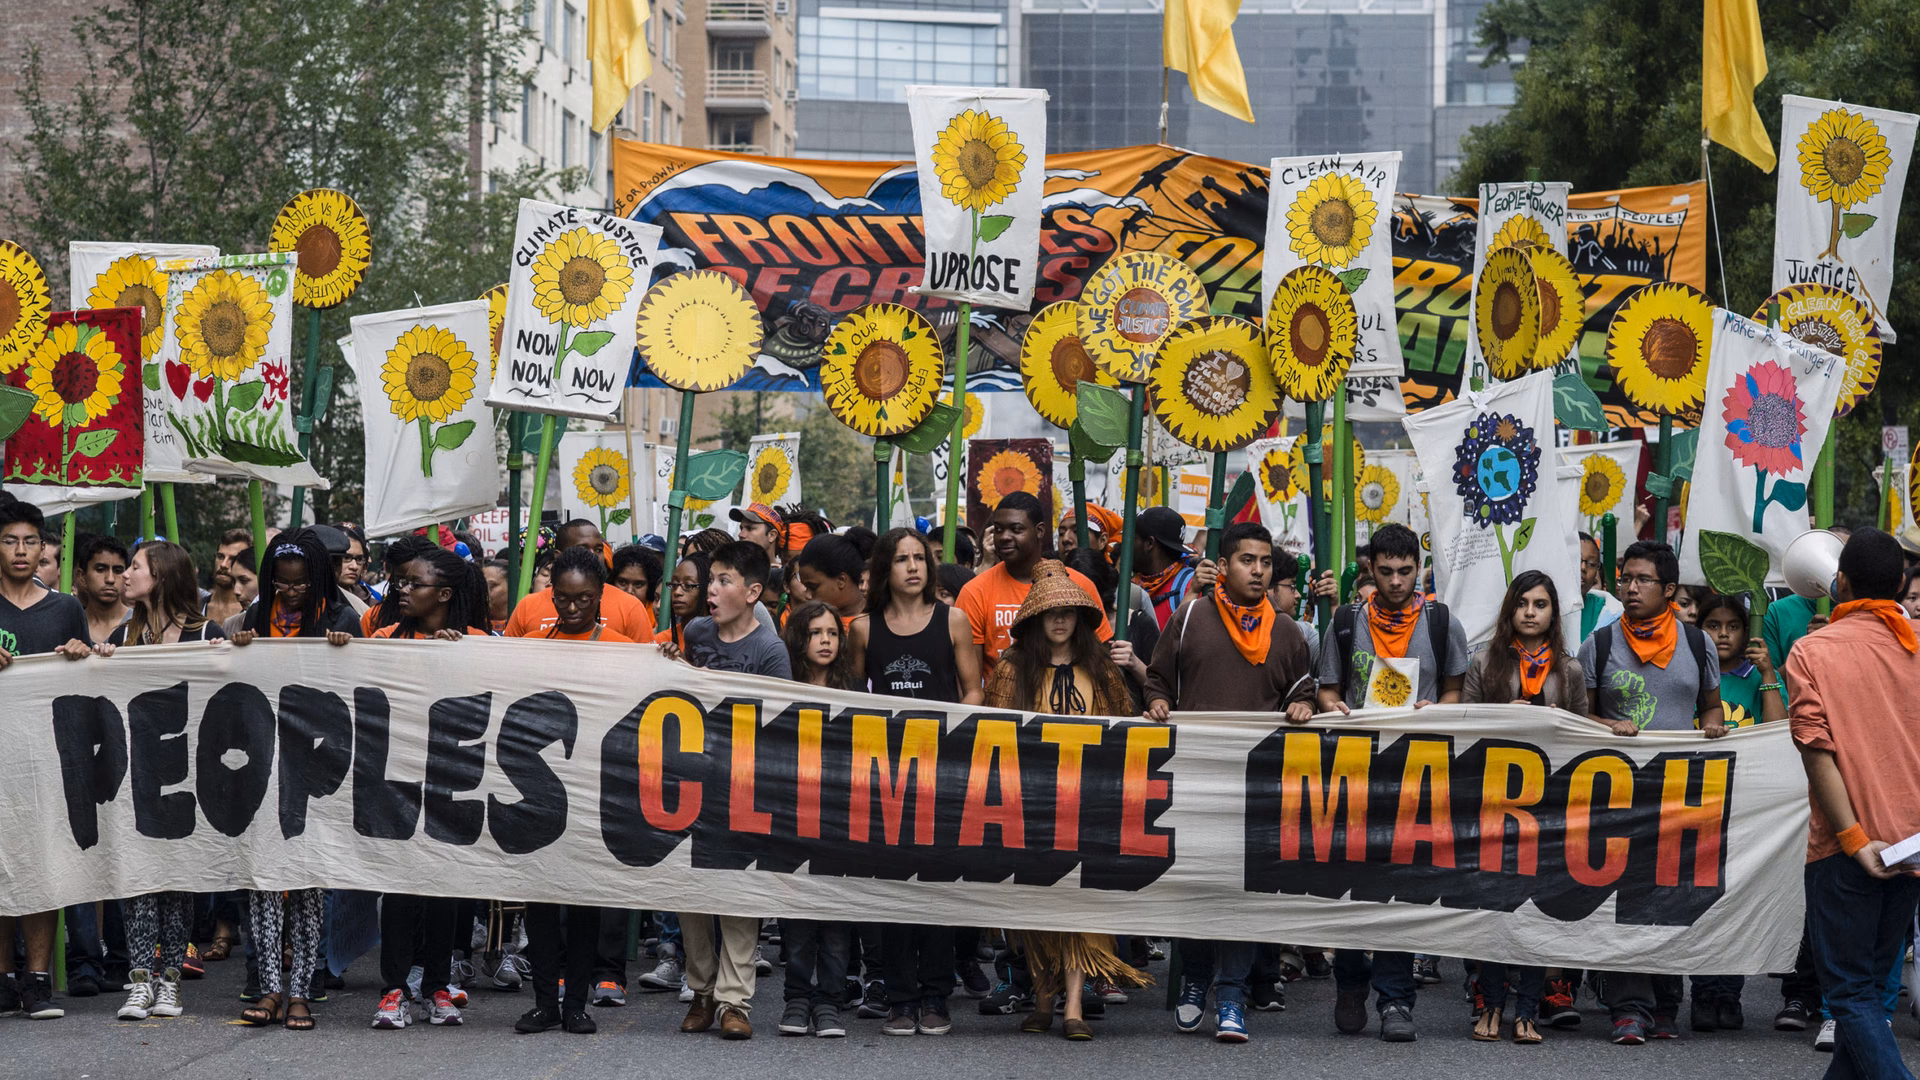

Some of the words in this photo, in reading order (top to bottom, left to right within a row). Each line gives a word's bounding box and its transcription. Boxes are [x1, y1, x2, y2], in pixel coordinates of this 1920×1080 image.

[1282, 157, 1341, 185] CLEAN
[1352, 160, 1386, 188] AIR
[626, 188, 641, 203] OR
[281, 203, 316, 238] JUSTICE
[336, 209, 359, 246] WALL
[1621, 211, 1681, 224] PEOPLE!
[516, 208, 578, 267] CLIMATE
[594, 214, 648, 268] JUSTICE
[14, 266, 39, 307] TODAY
[304, 265, 357, 299] POLLUTERS
[930, 252, 1020, 294] UPROSE
[1094, 266, 1125, 306] GOT
[1126, 261, 1171, 286] THE
[1785, 258, 1857, 295] Justice
[1281, 277, 1321, 316] CLIMATE
[18, 310, 44, 345] STAY
[1089, 307, 1109, 335] WE
[1116, 316, 1169, 336] JUSTICE
[1324, 287, 1348, 344] JUSTICE
[1722, 311, 1756, 339] Make
[516, 329, 558, 357] NOW
[1275, 315, 1287, 368] WANT
[1786, 297, 1843, 318] CLEAN
[1839, 348, 1869, 401] CLEAN
[1790, 320, 1842, 350] EALTHY
[511, 359, 552, 389] NOW
[571, 366, 615, 393] NOW
[828, 363, 859, 411] HELP
[851, 321, 879, 346] OUR
[901, 368, 929, 410] EARTH
[1284, 364, 1301, 390] WE
[891, 680, 923, 690] maui
[52, 681, 578, 854] PEOPLES
[628, 693, 1174, 868] CLIMATE
[1268, 730, 1733, 898] MARCH
